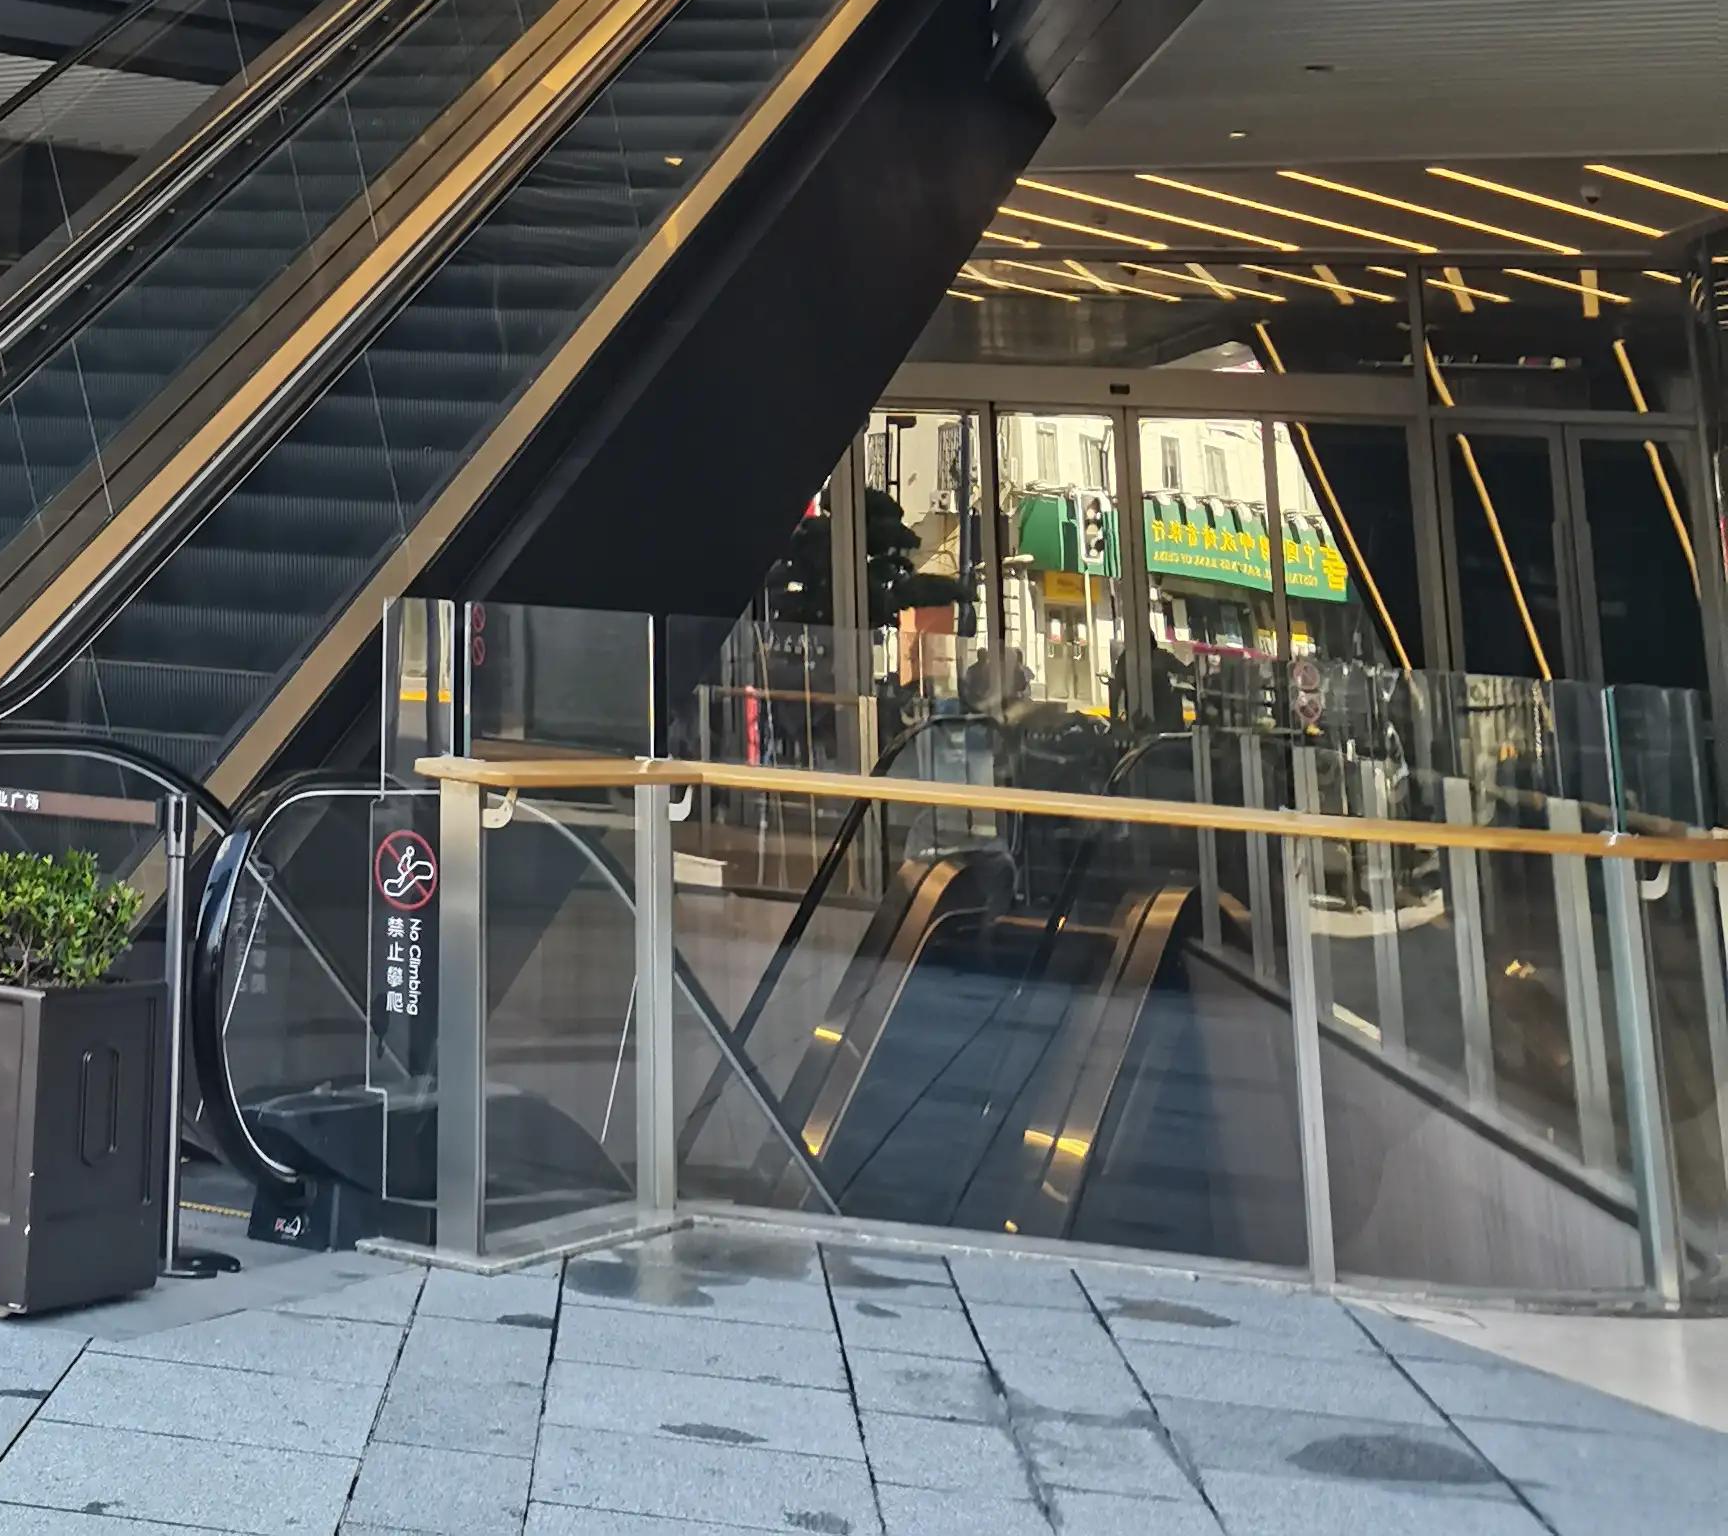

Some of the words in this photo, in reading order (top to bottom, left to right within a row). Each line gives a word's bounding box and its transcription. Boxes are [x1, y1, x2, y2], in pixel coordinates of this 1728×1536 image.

[385, 915, 405, 1014] 禁止攀爬
[408, 917, 422, 942] No
[406, 943, 422, 1017] Climbing
